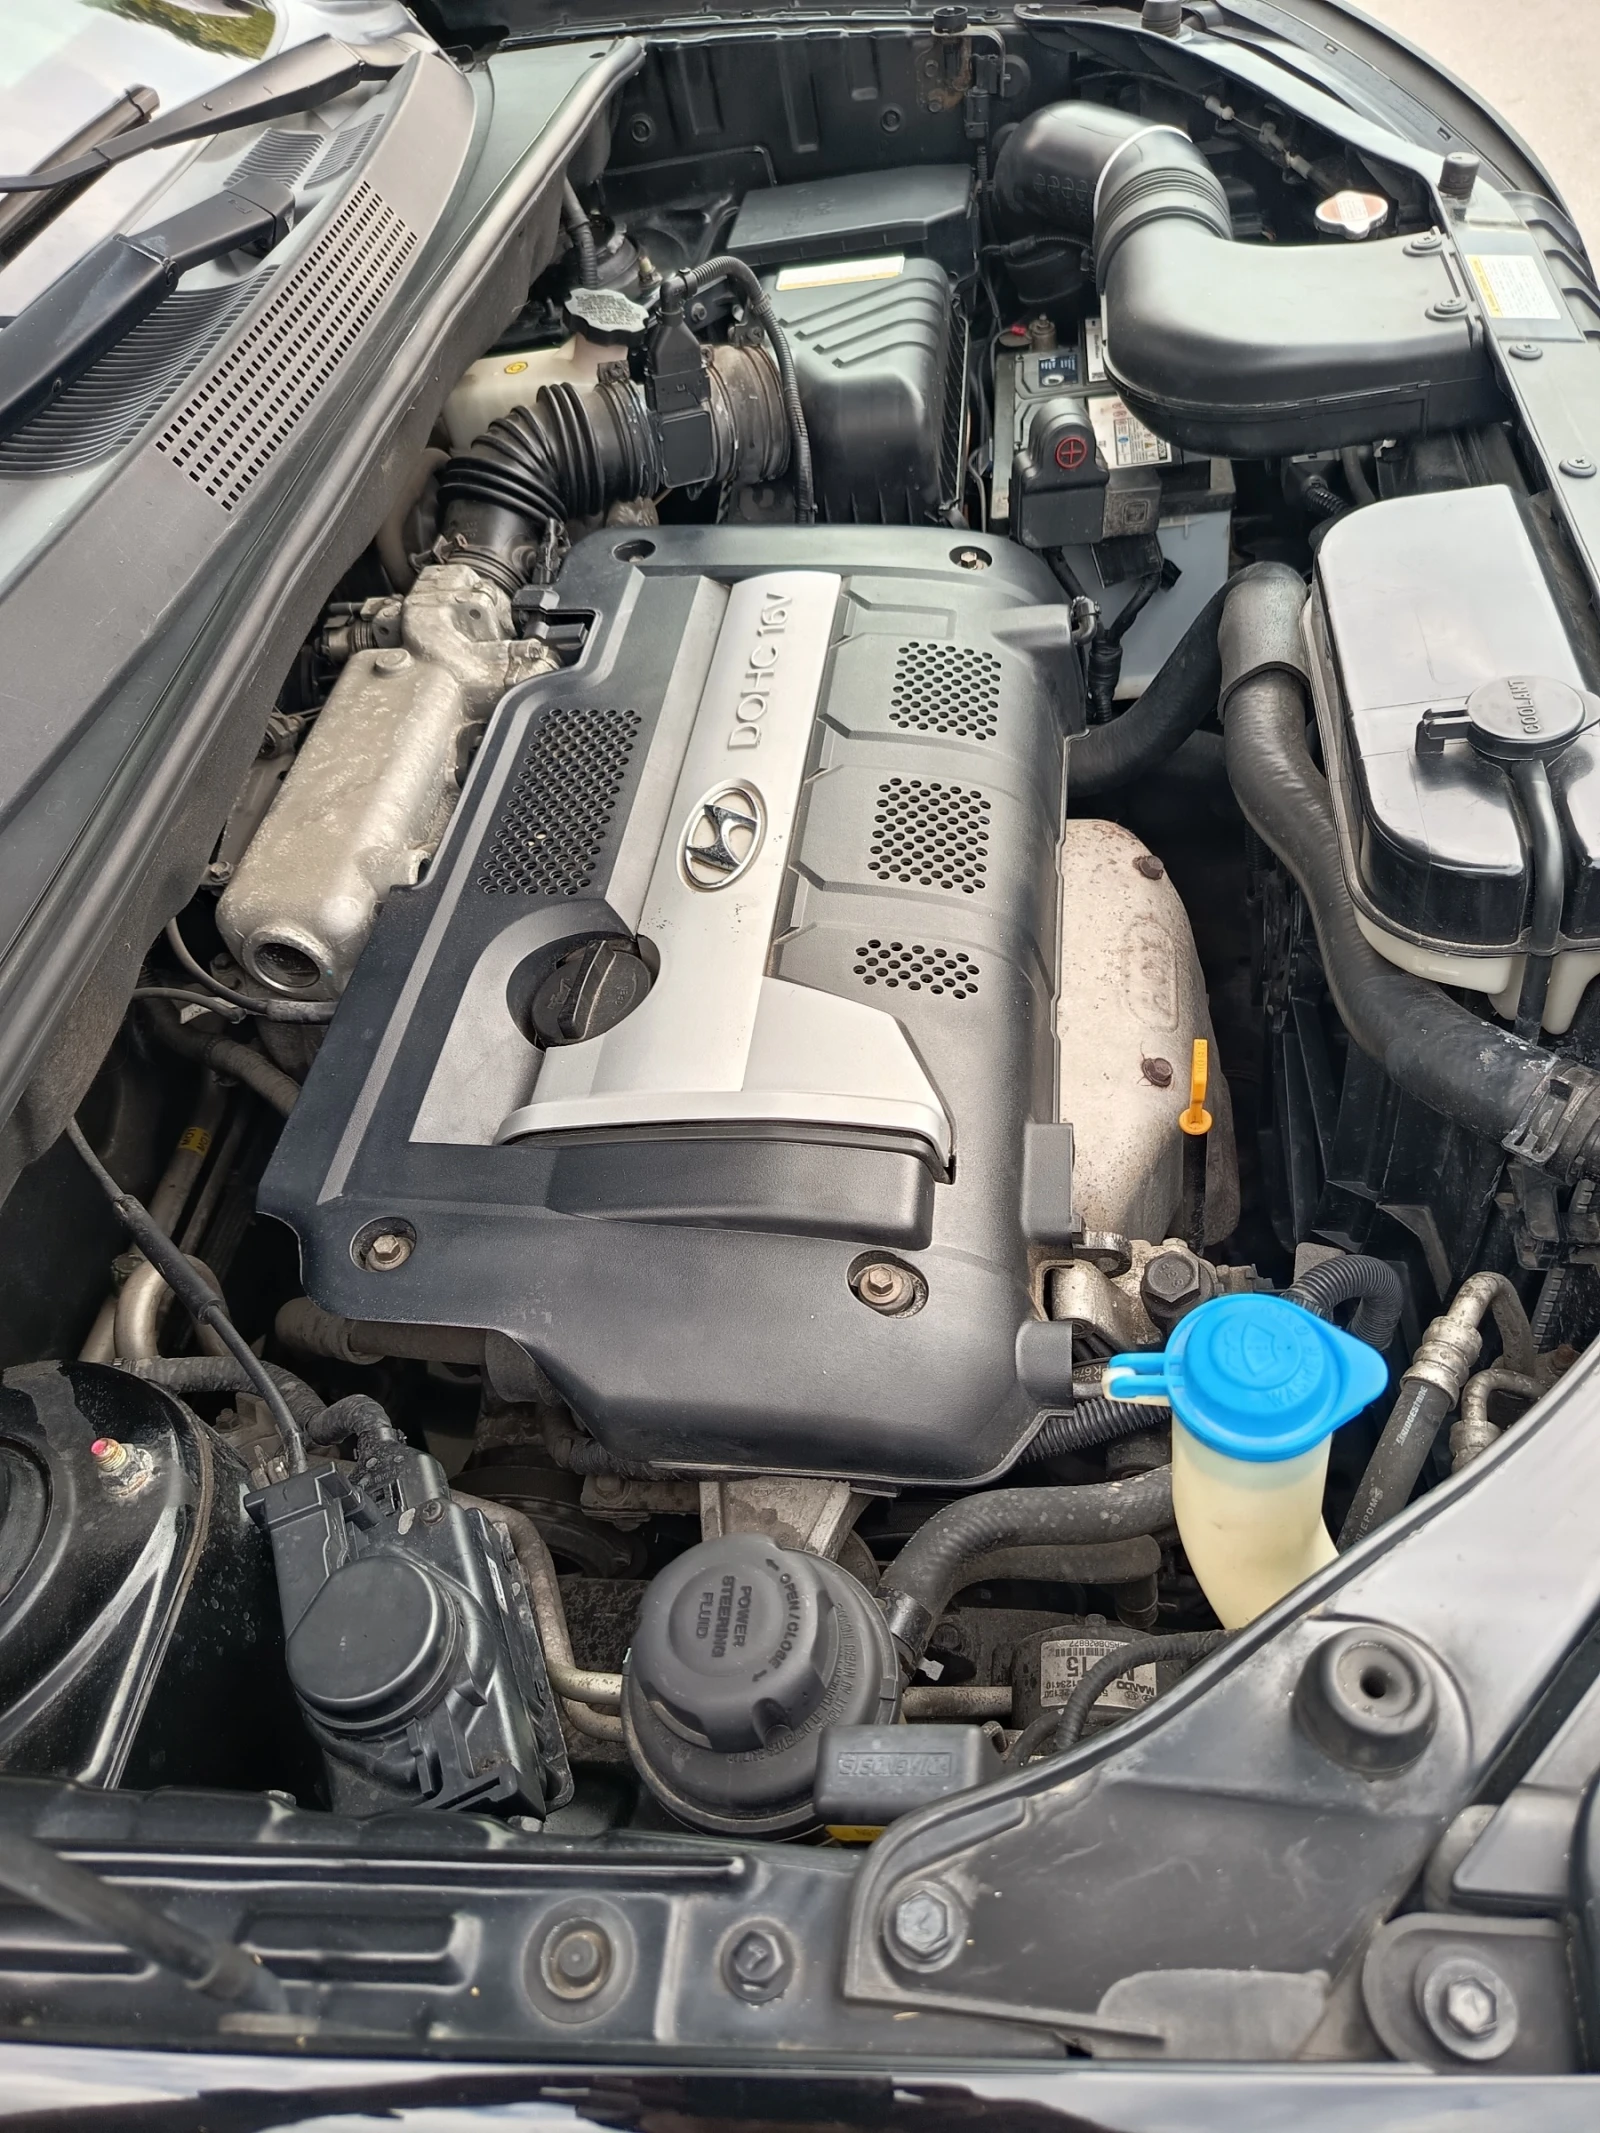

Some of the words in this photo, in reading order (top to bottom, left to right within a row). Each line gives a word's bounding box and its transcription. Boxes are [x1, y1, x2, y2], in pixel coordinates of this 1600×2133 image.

[728, 645, 779, 751] DOHC
[756, 592, 793, 638] 16V
[1507, 680, 1541, 734] COOLANT
[1266, 1344, 1323, 1409] WASHER
[1396, 1385, 1429, 1447] BRIDGESTONE
[1352, 1496, 1380, 1545] R/EPDM
[696, 1591, 715, 1640] FLUID
[711, 1575, 736, 1659] STEERING
[733, 1585, 752, 1648] POWER
[1116, 1680, 1155, 1696] MANDO
